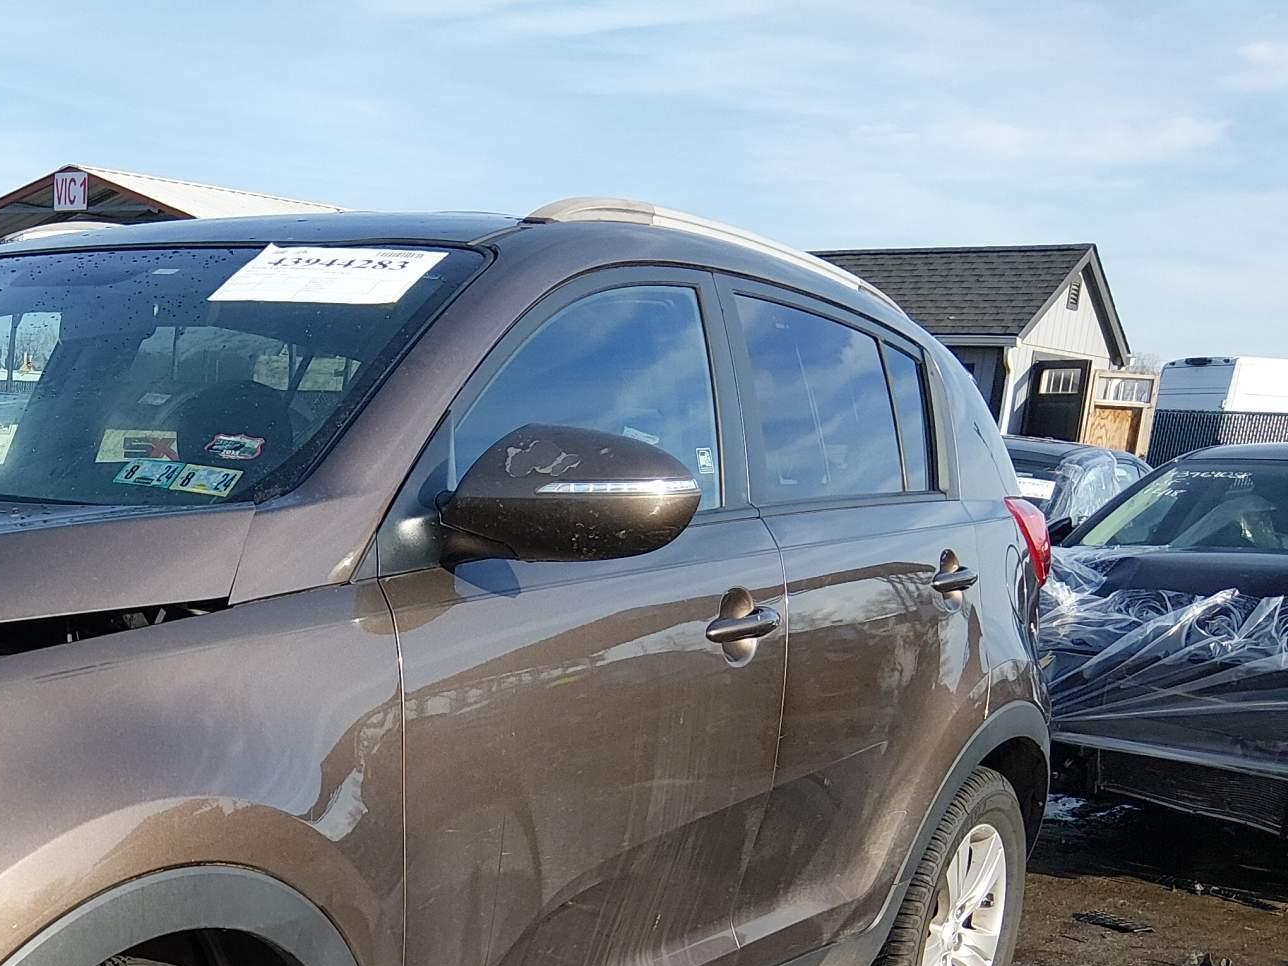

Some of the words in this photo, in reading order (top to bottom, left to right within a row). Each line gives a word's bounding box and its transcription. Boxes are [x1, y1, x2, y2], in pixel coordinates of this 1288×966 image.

[55, 176, 77, 205] VIC
[79, 176, 87, 205] 1
[267, 256, 410, 271] 43944283
[124, 464, 140, 480] 8
[156, 464, 180, 482] 24
[180, 471, 196, 487] 8
[213, 472, 238, 491] 24
